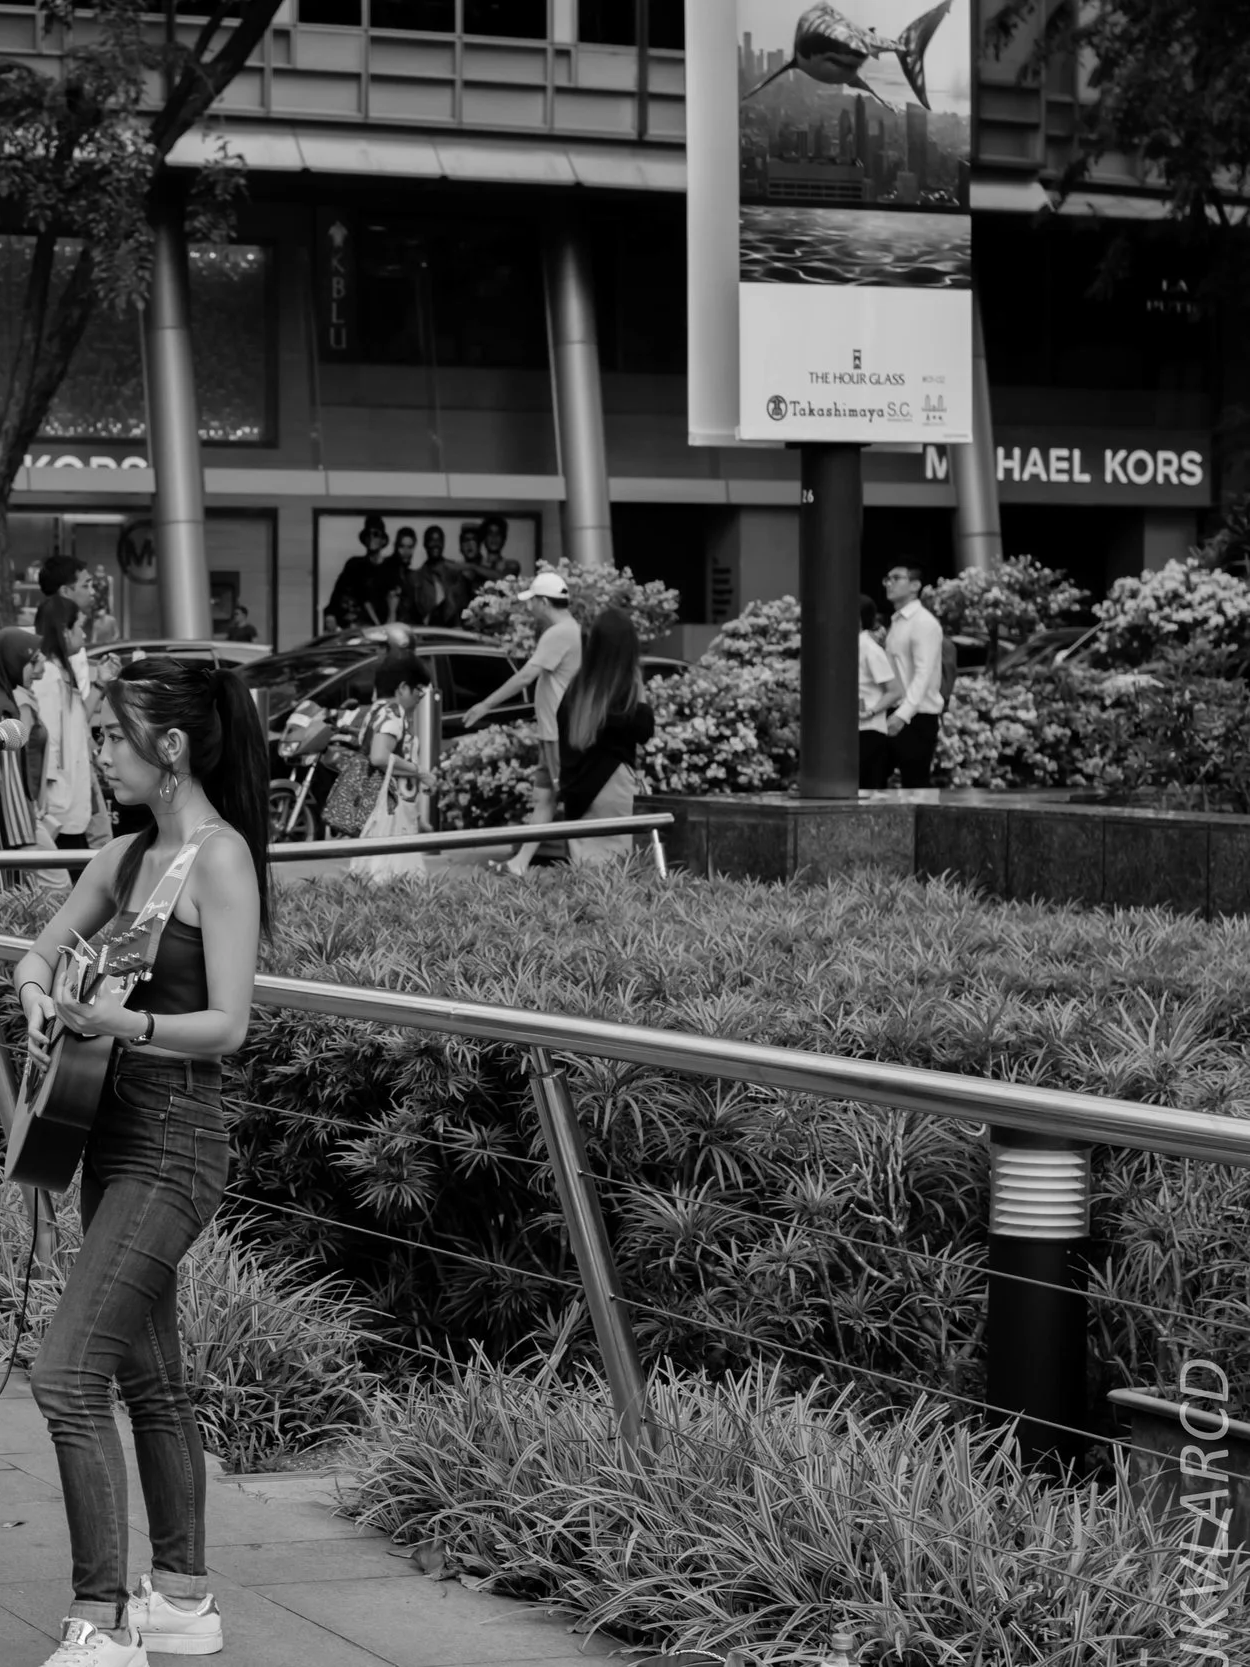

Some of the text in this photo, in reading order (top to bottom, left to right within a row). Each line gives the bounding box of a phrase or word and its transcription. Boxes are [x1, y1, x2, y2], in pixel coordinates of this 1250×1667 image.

[809, 372, 906, 386] THE HOUR GLASS
[790, 400, 884, 423] Takashimaya
[925, 446, 1203, 486] MHAEL KORS
